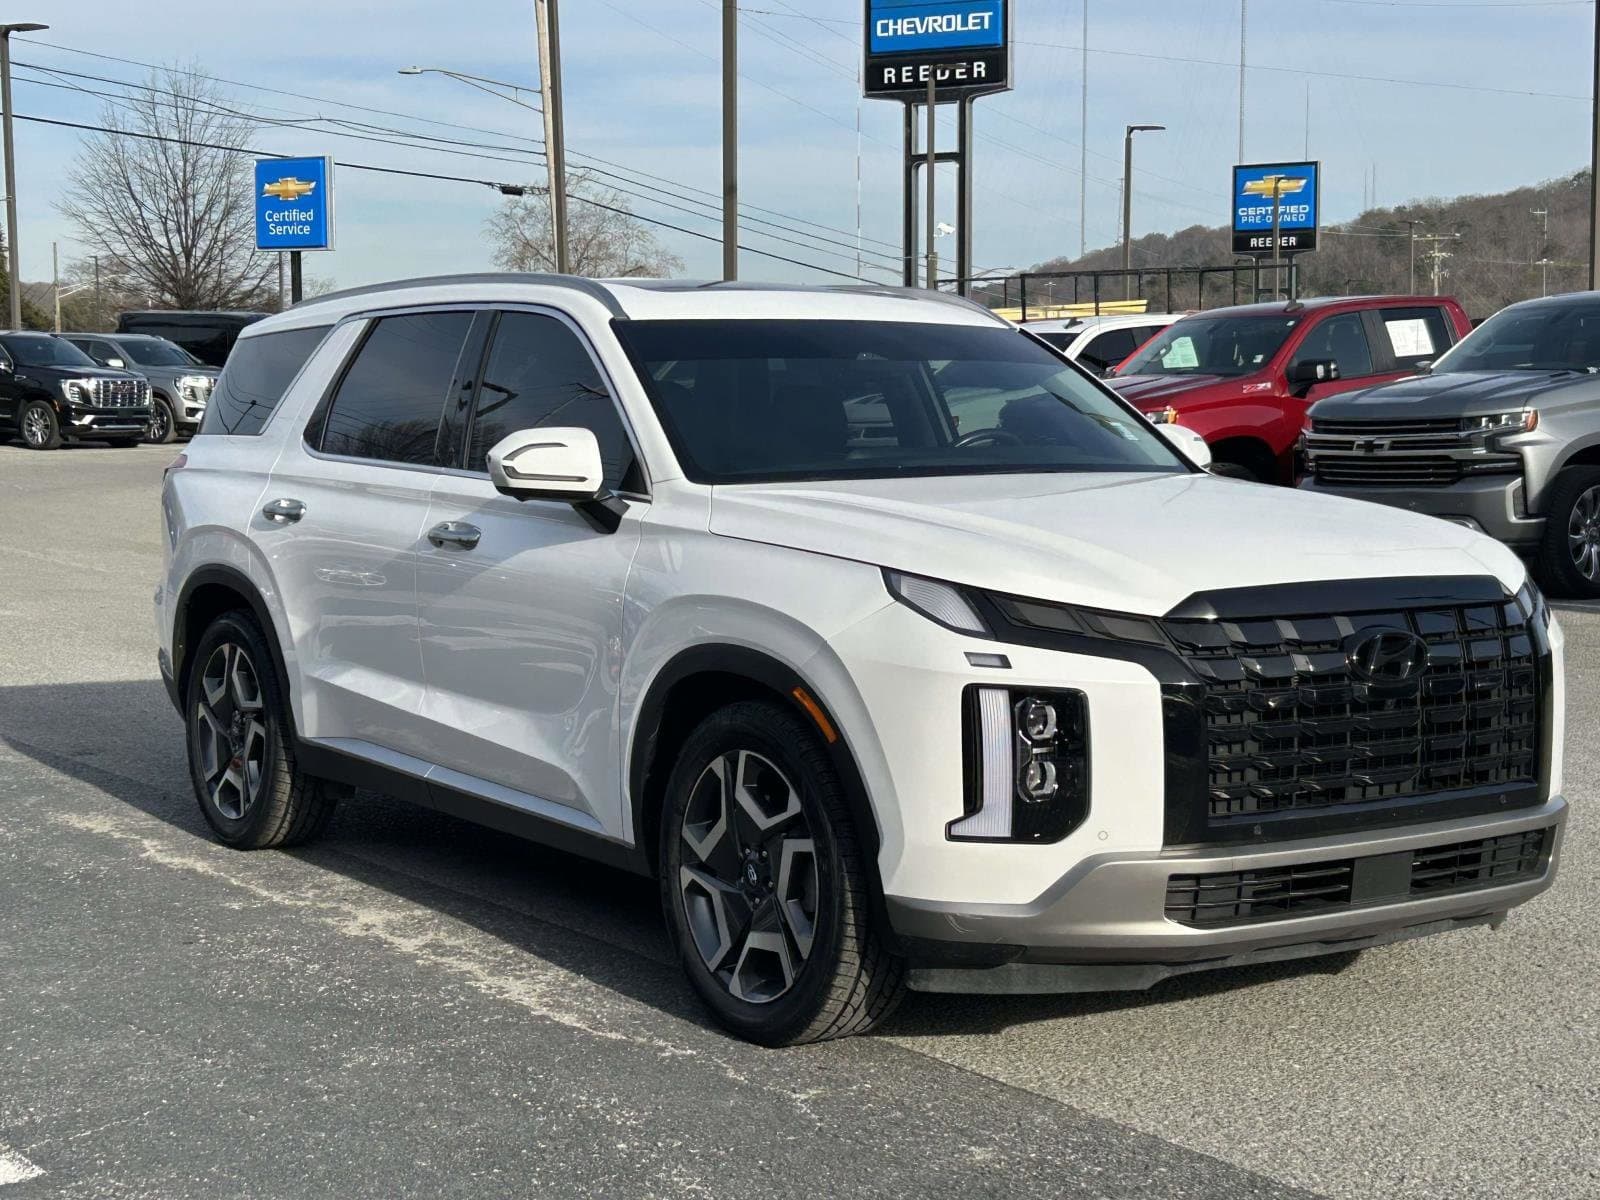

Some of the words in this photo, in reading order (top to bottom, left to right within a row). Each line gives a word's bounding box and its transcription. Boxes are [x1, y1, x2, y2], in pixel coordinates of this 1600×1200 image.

[876, 12, 993, 37] CHEVROLET
[883, 61, 986, 84] REEDER
[265, 209, 314, 222] Certified
[1238, 205, 1309, 216] CERTFIED
[268, 223, 311, 235] Service
